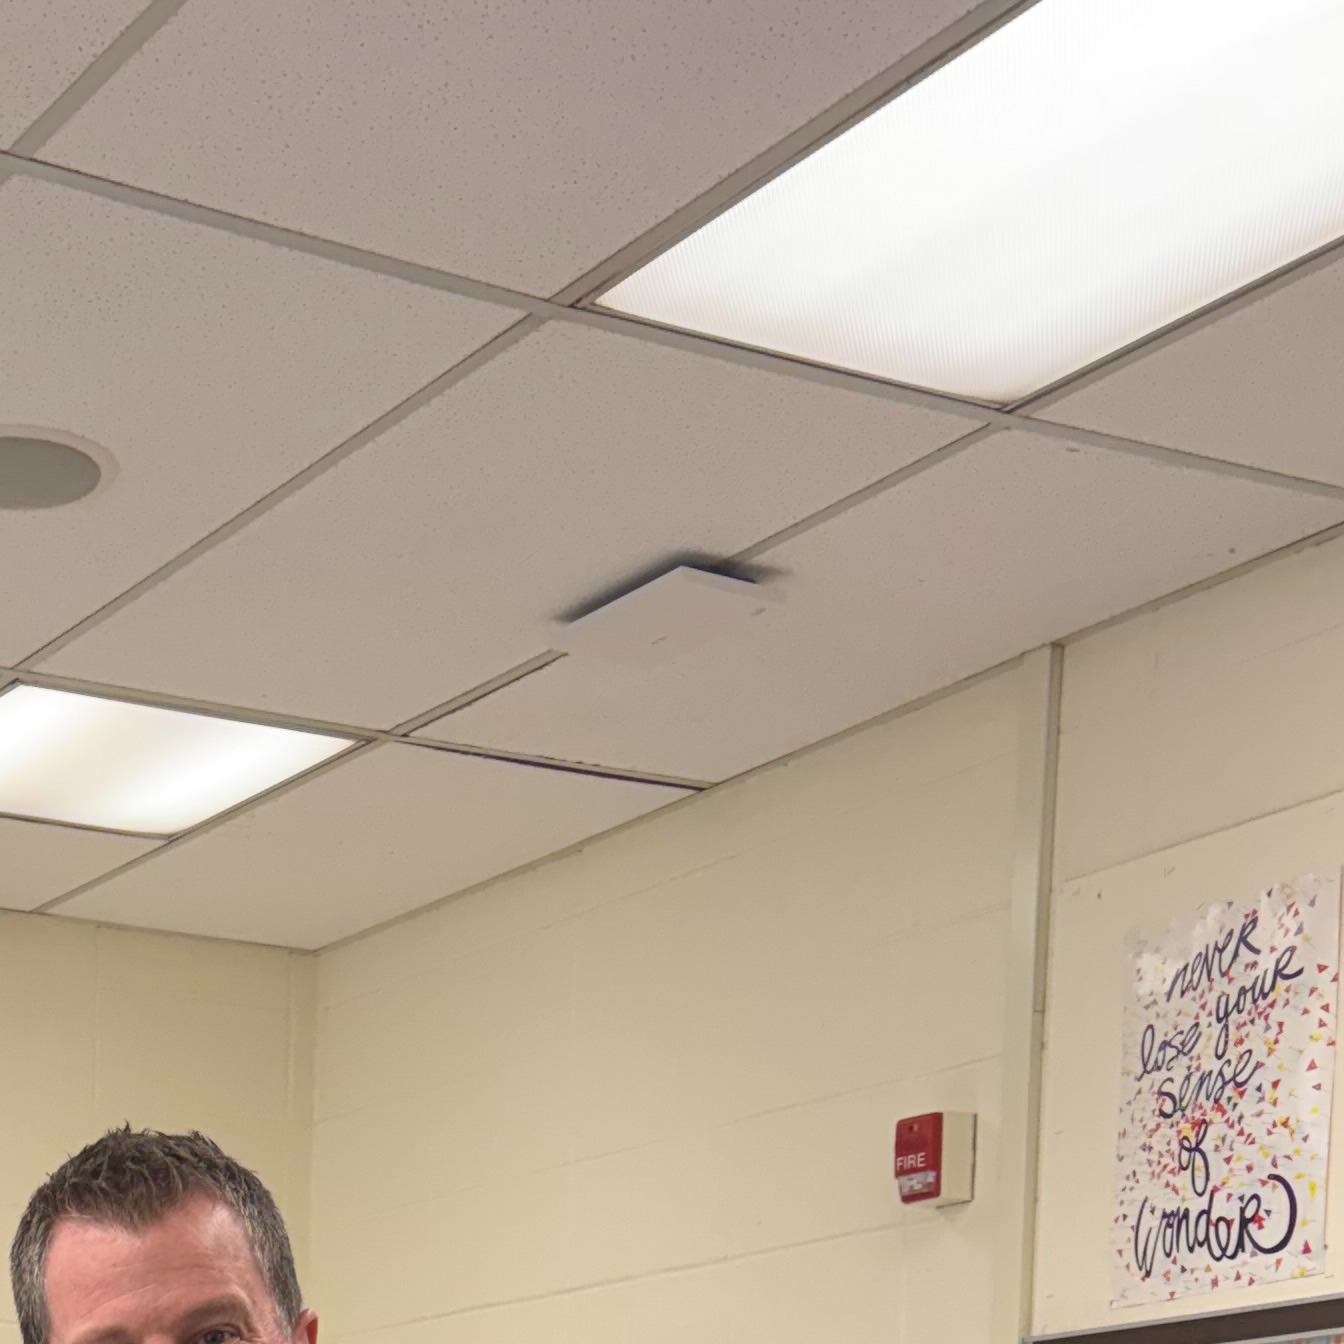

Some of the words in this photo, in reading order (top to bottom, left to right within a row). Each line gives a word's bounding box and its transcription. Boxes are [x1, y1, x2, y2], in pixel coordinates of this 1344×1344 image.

[1137, 1024, 1201, 1082] lose
[896, 1152, 927, 1171] FIRE
[1177, 1119, 1210, 1197] of
